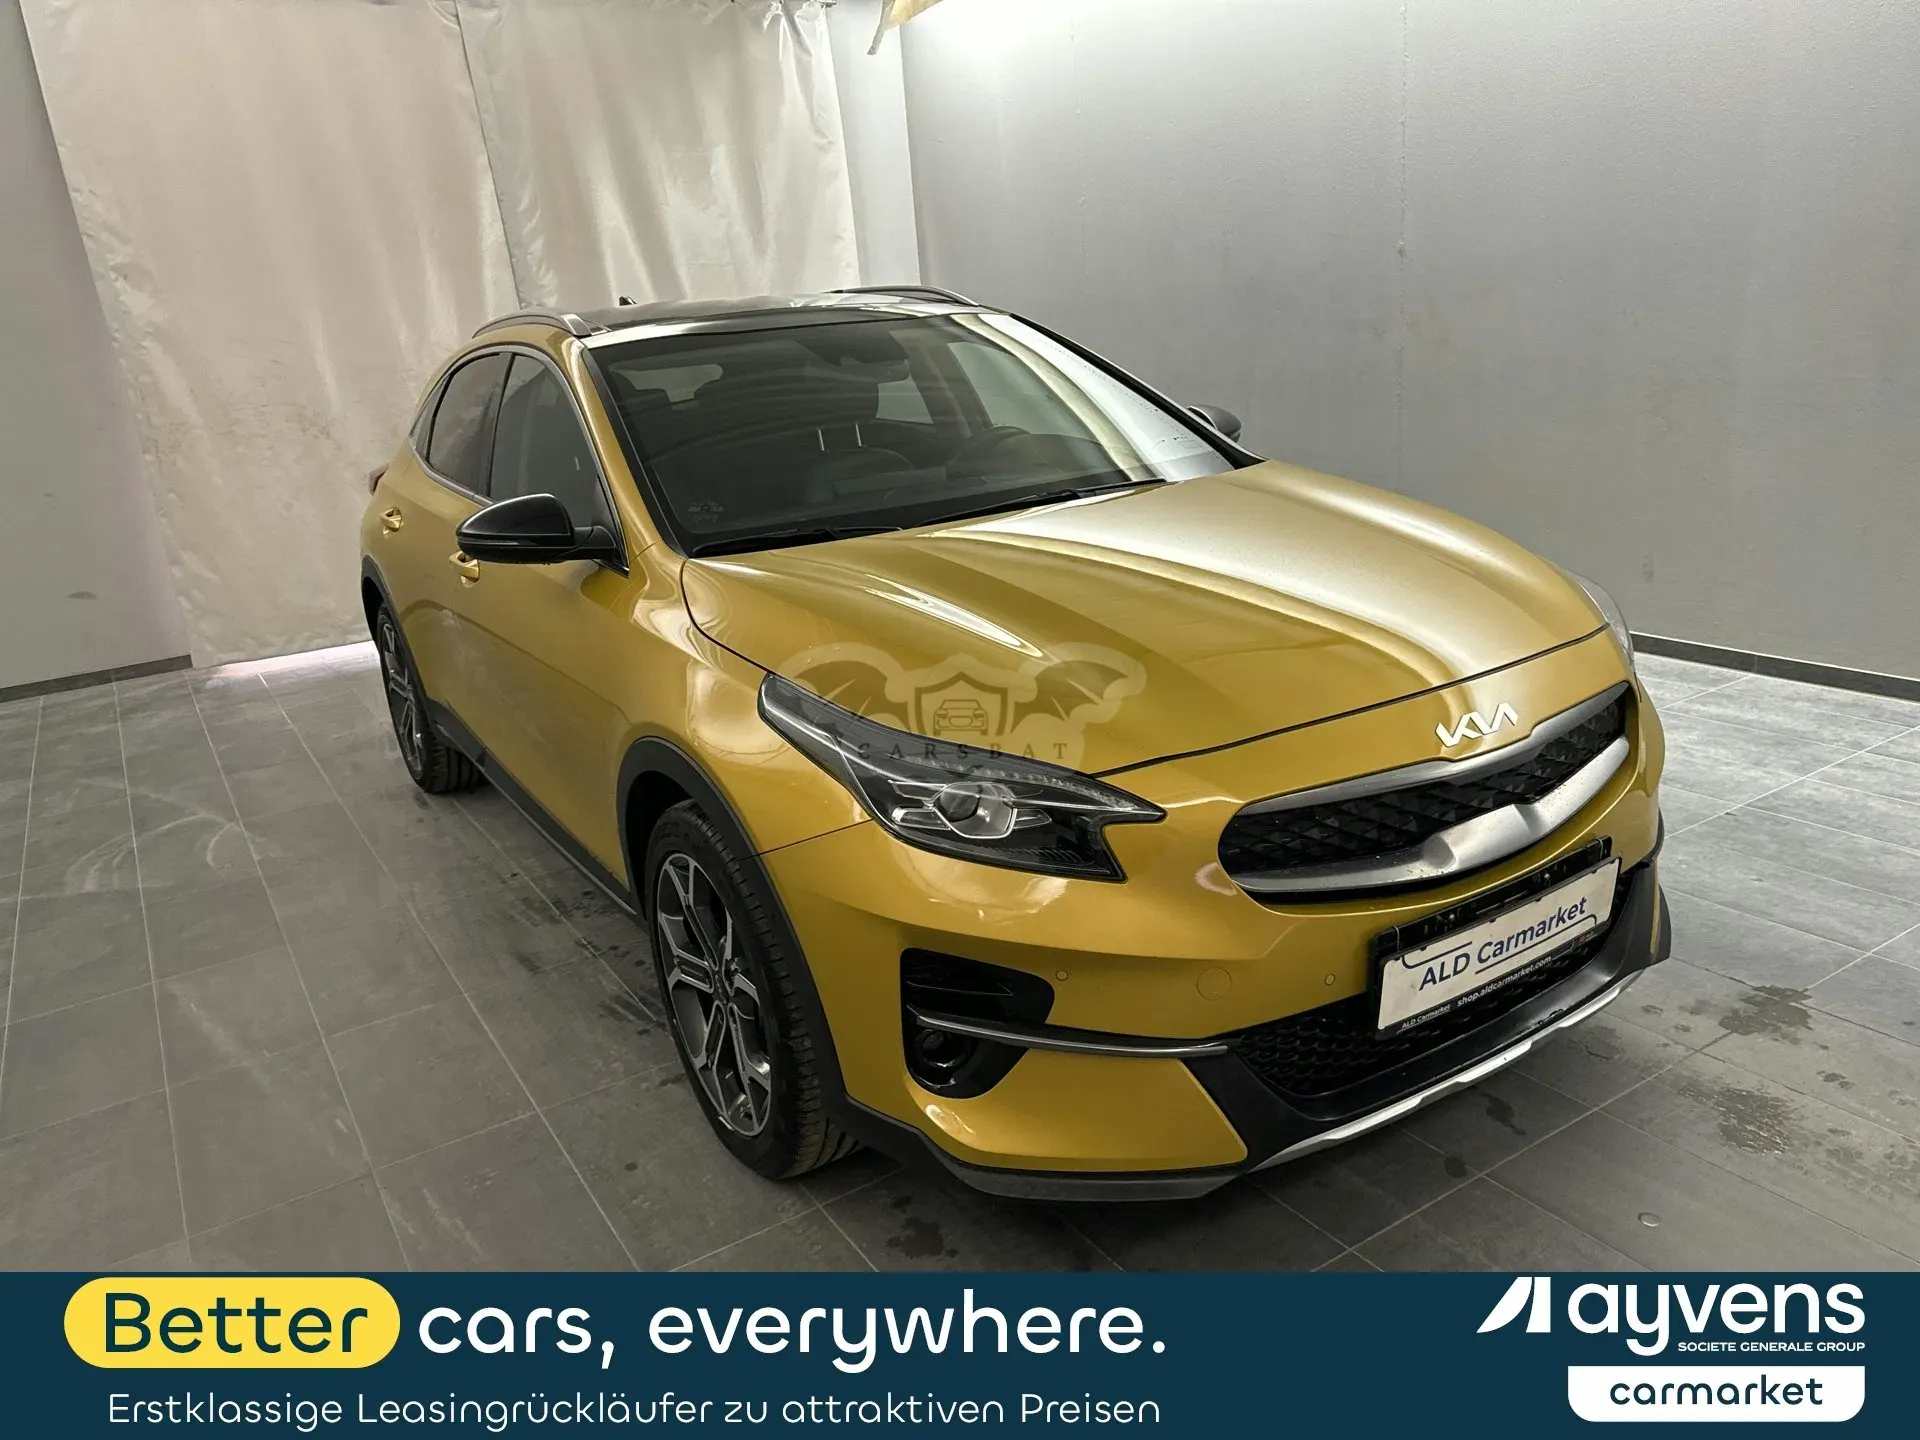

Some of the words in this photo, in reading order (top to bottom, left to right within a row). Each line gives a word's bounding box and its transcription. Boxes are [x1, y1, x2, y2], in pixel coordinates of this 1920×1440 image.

[1419, 952, 1471, 992] ALD
[1477, 896, 1587, 965] Carmarket
[1456, 955, 1552, 1008] shop.aldcarmarket.com
[1401, 1018, 1417, 1030] ALD
[1417, 1003, 1451, 1024] Carmarket
